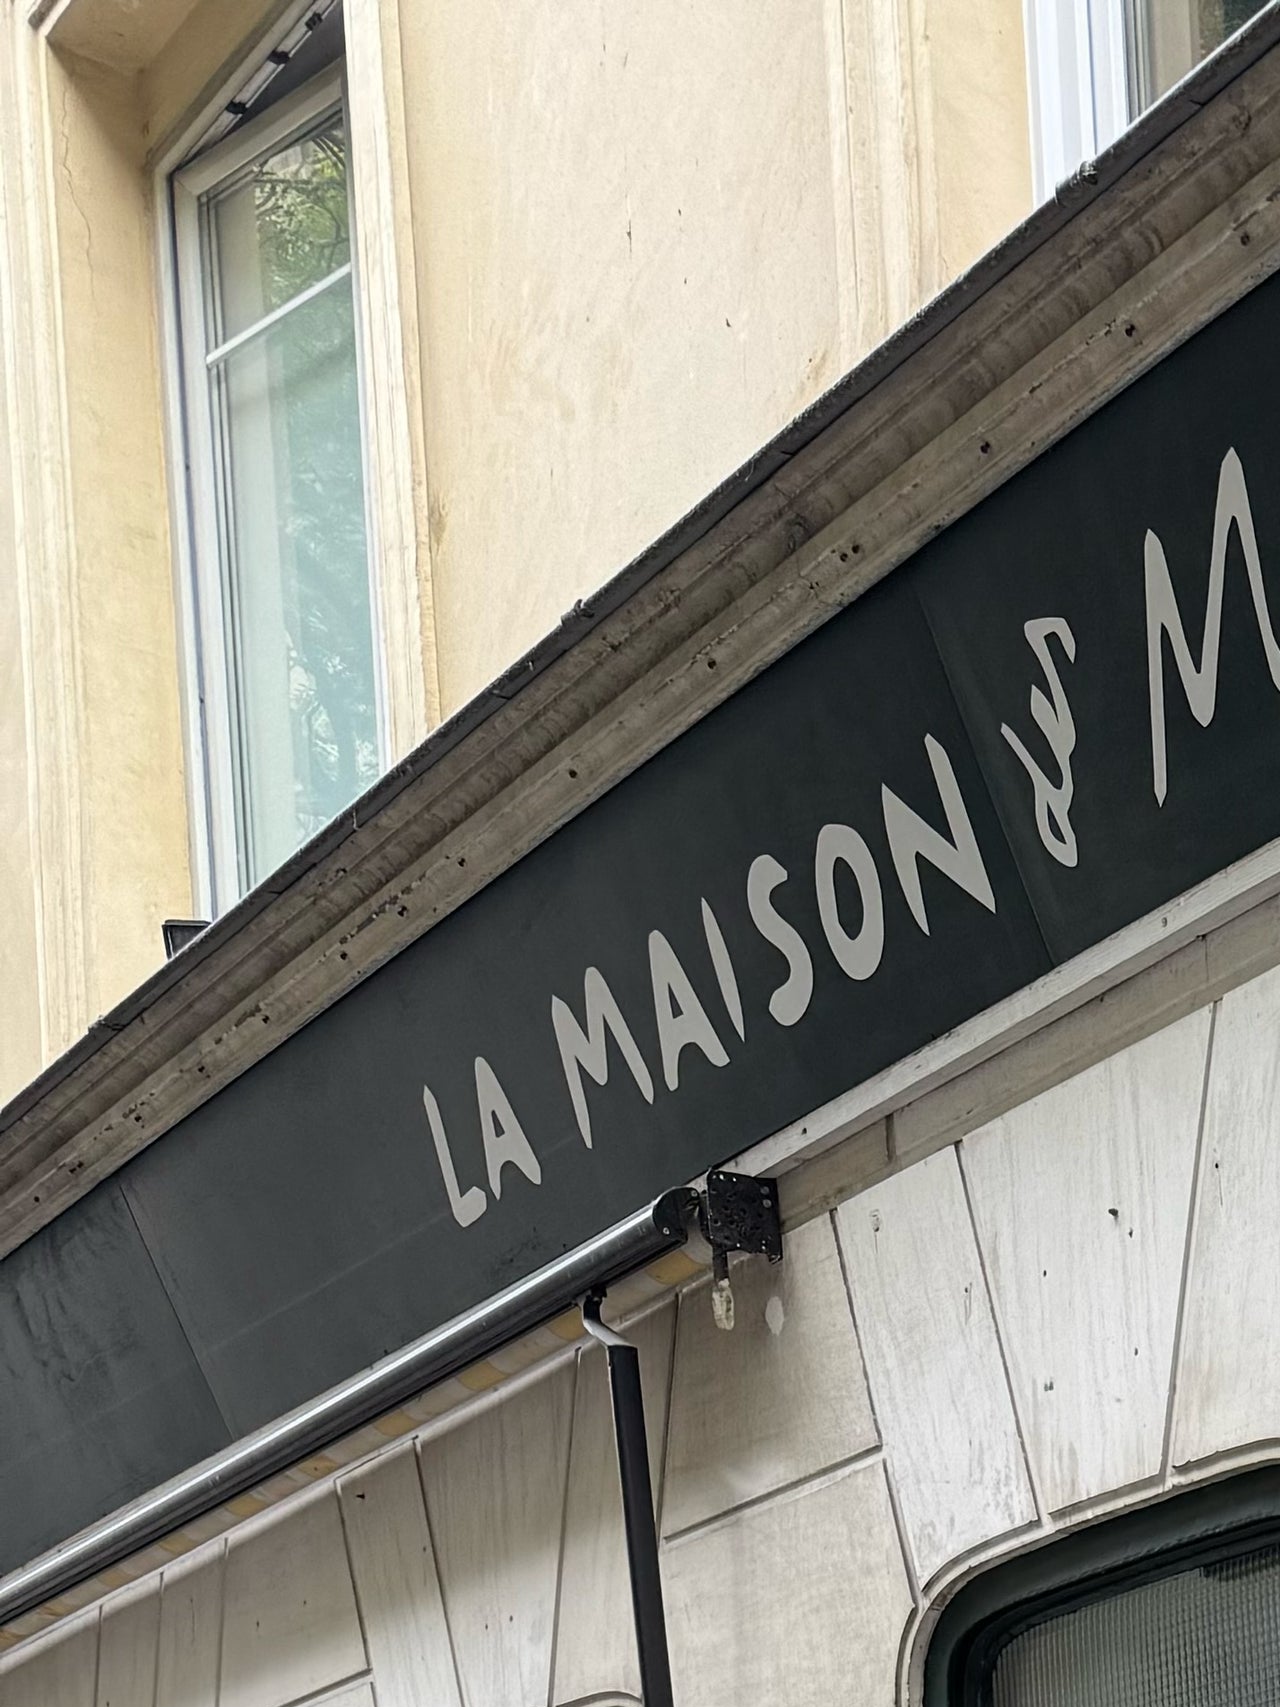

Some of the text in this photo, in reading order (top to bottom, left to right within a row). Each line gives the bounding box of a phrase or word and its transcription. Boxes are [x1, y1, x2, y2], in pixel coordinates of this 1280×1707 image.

[424, 1086, 541, 1227] LA
[552, 734, 995, 1148] MAISON
[1001, 618, 1077, 867] des
